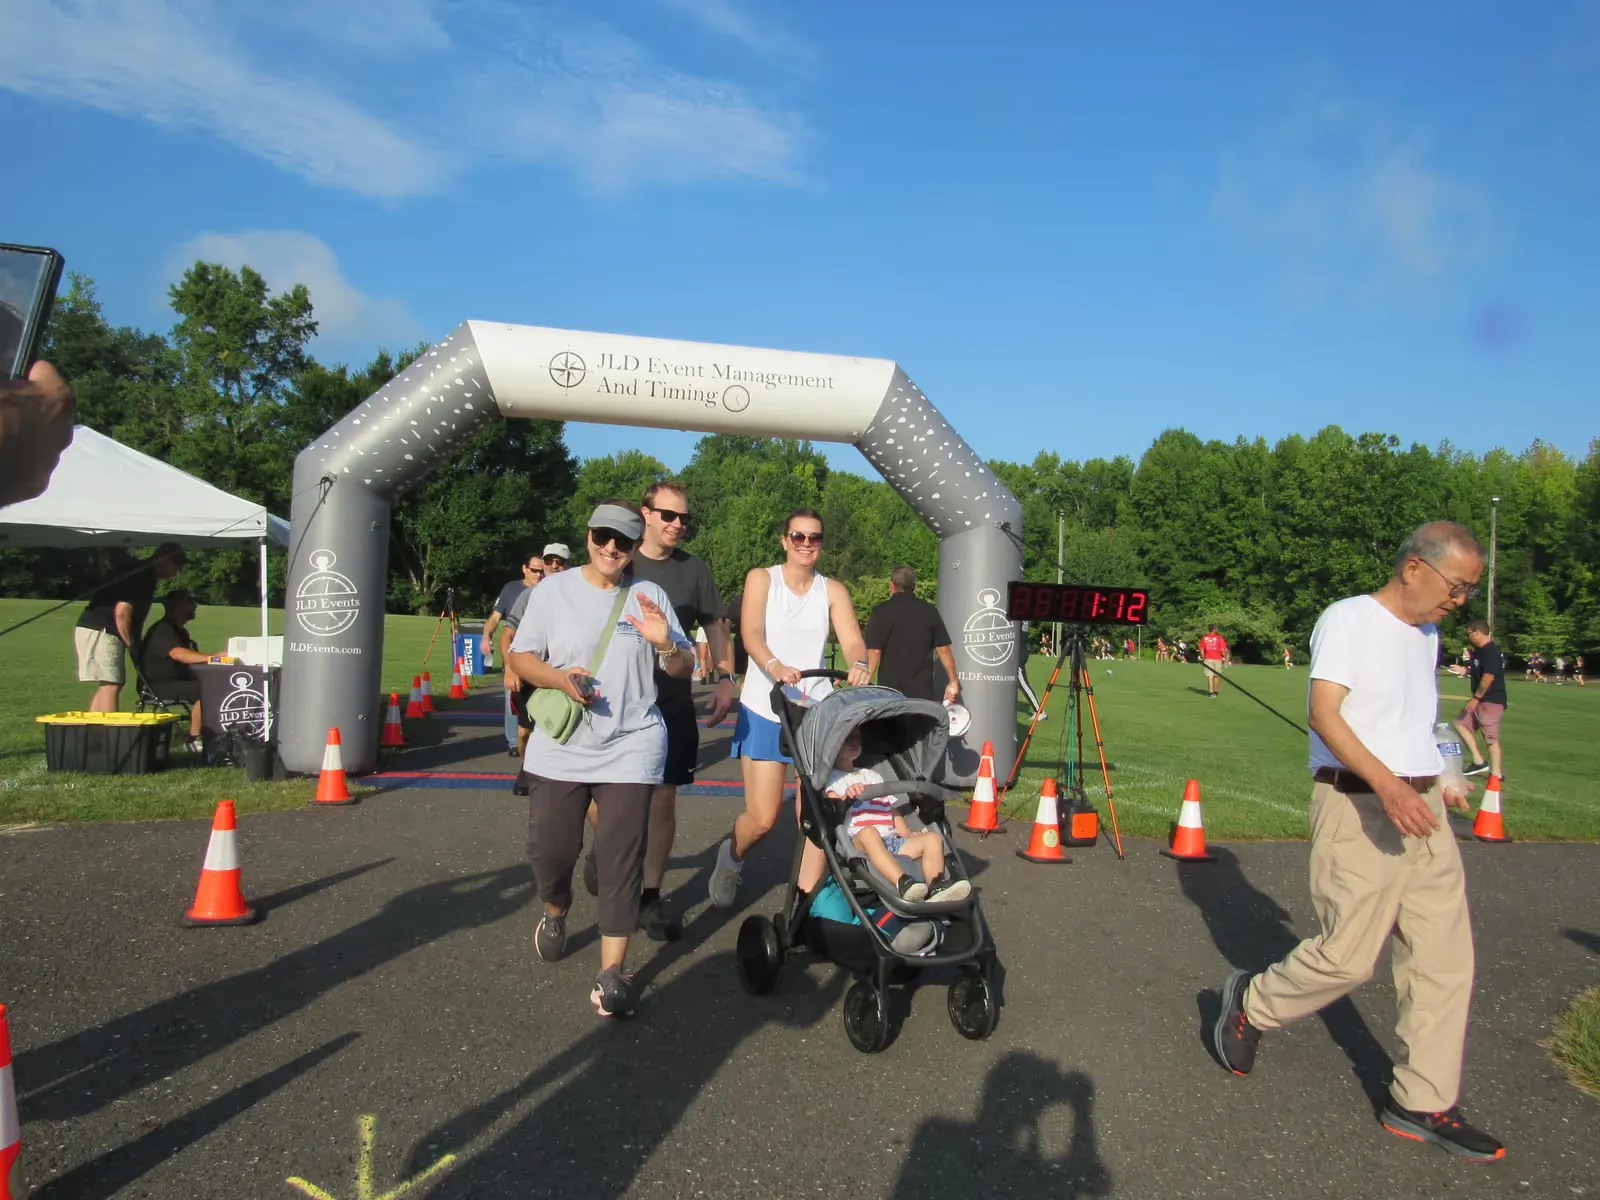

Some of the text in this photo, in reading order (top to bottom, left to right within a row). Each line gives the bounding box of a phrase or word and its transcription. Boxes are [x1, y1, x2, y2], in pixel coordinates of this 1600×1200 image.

[597, 353, 835, 389] JLD Event Management
[597, 376, 719, 408] And Timing
[296, 598, 360, 611] JLD Events
[963, 632, 1016, 644] JLD Events
[289, 642, 362, 654] JLDEvents.com
[958, 671, 1016, 682] JLDEvents.com
[220, 710, 273, 722] JLD Evens
